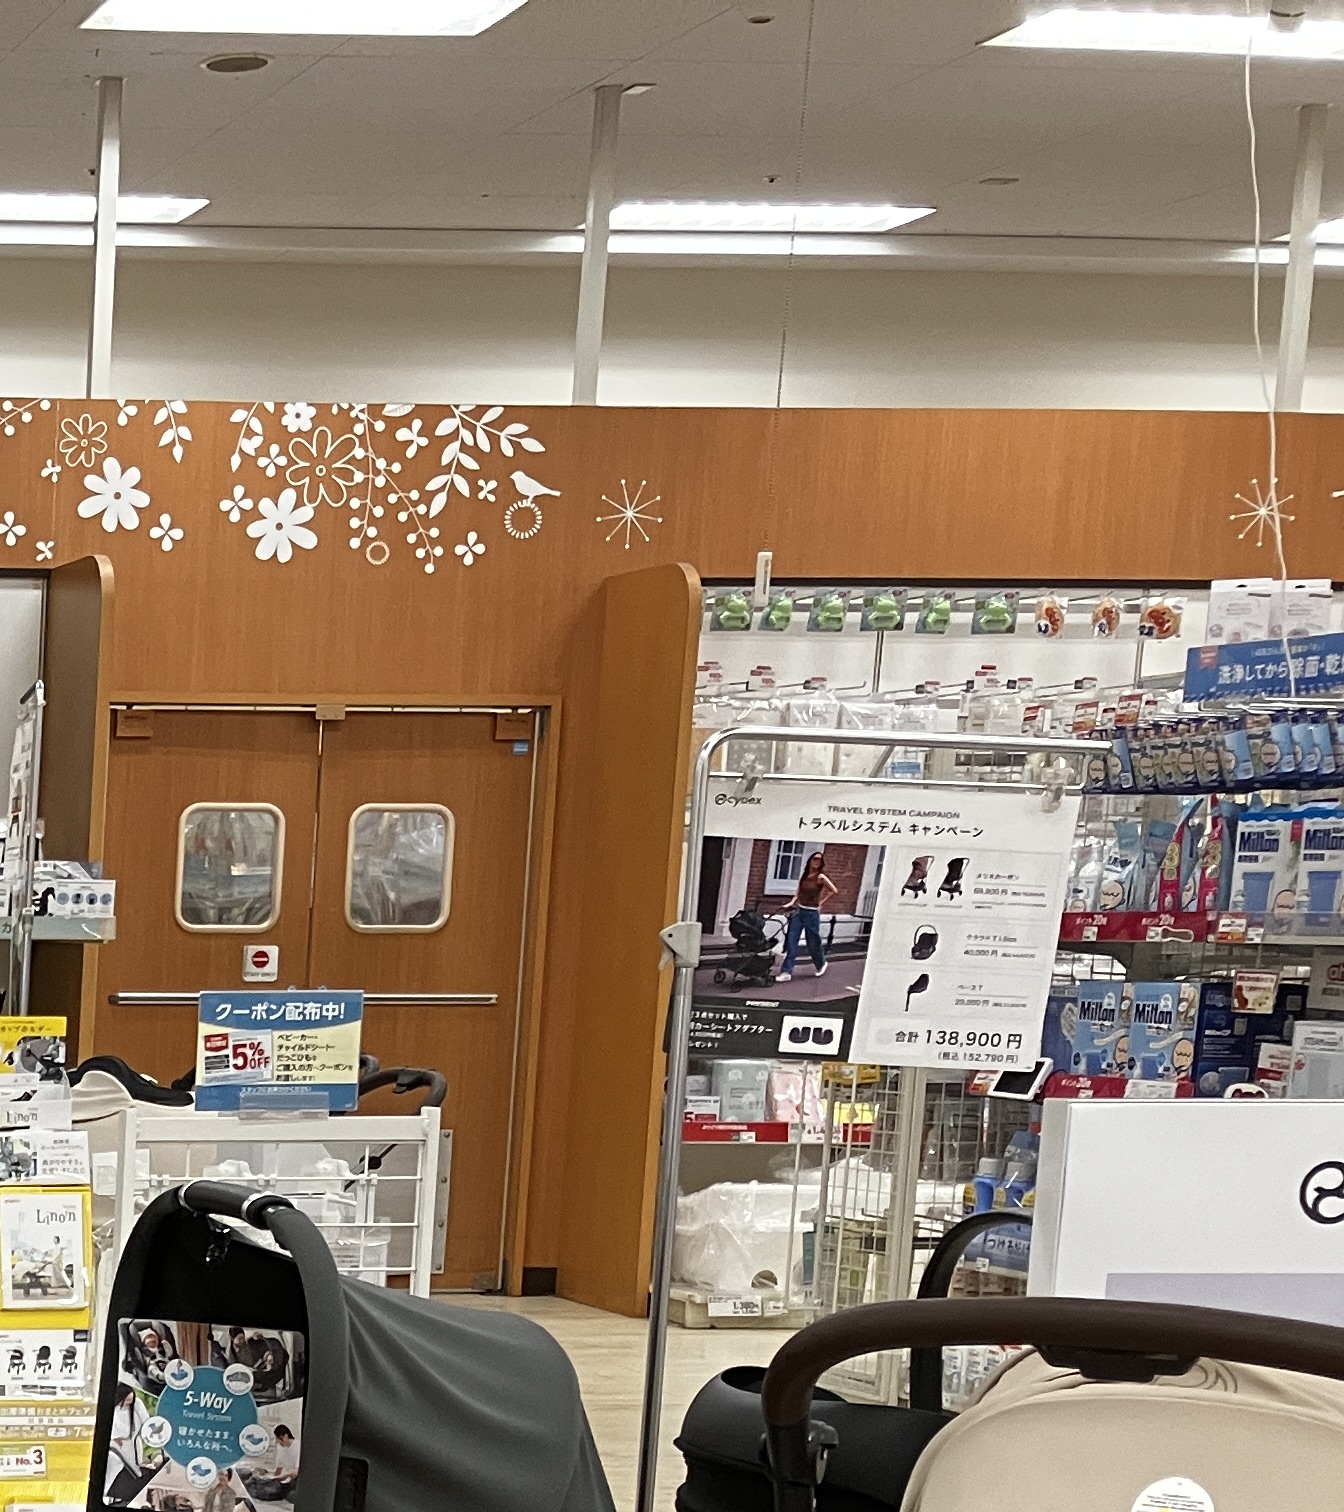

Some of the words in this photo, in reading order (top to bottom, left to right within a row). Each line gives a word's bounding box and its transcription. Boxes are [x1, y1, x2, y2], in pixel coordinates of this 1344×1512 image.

[798, 816, 902, 835] トラベルシステム
[908, 822, 984, 839] キャンペーン
[215, 1001, 345, 1021] クーポン配布中!
[1079, 1000, 1116, 1022] Milton
[1133, 1003, 1173, 1025] Milton
[895, 1030, 919, 1044] 合計
[924, 1029, 1001, 1049] 138,900
[1005, 1034, 1023, 1050] 円
[249, 1056, 270, 1070] OFF
[183, 1390, 233, 1414] 5-Way
